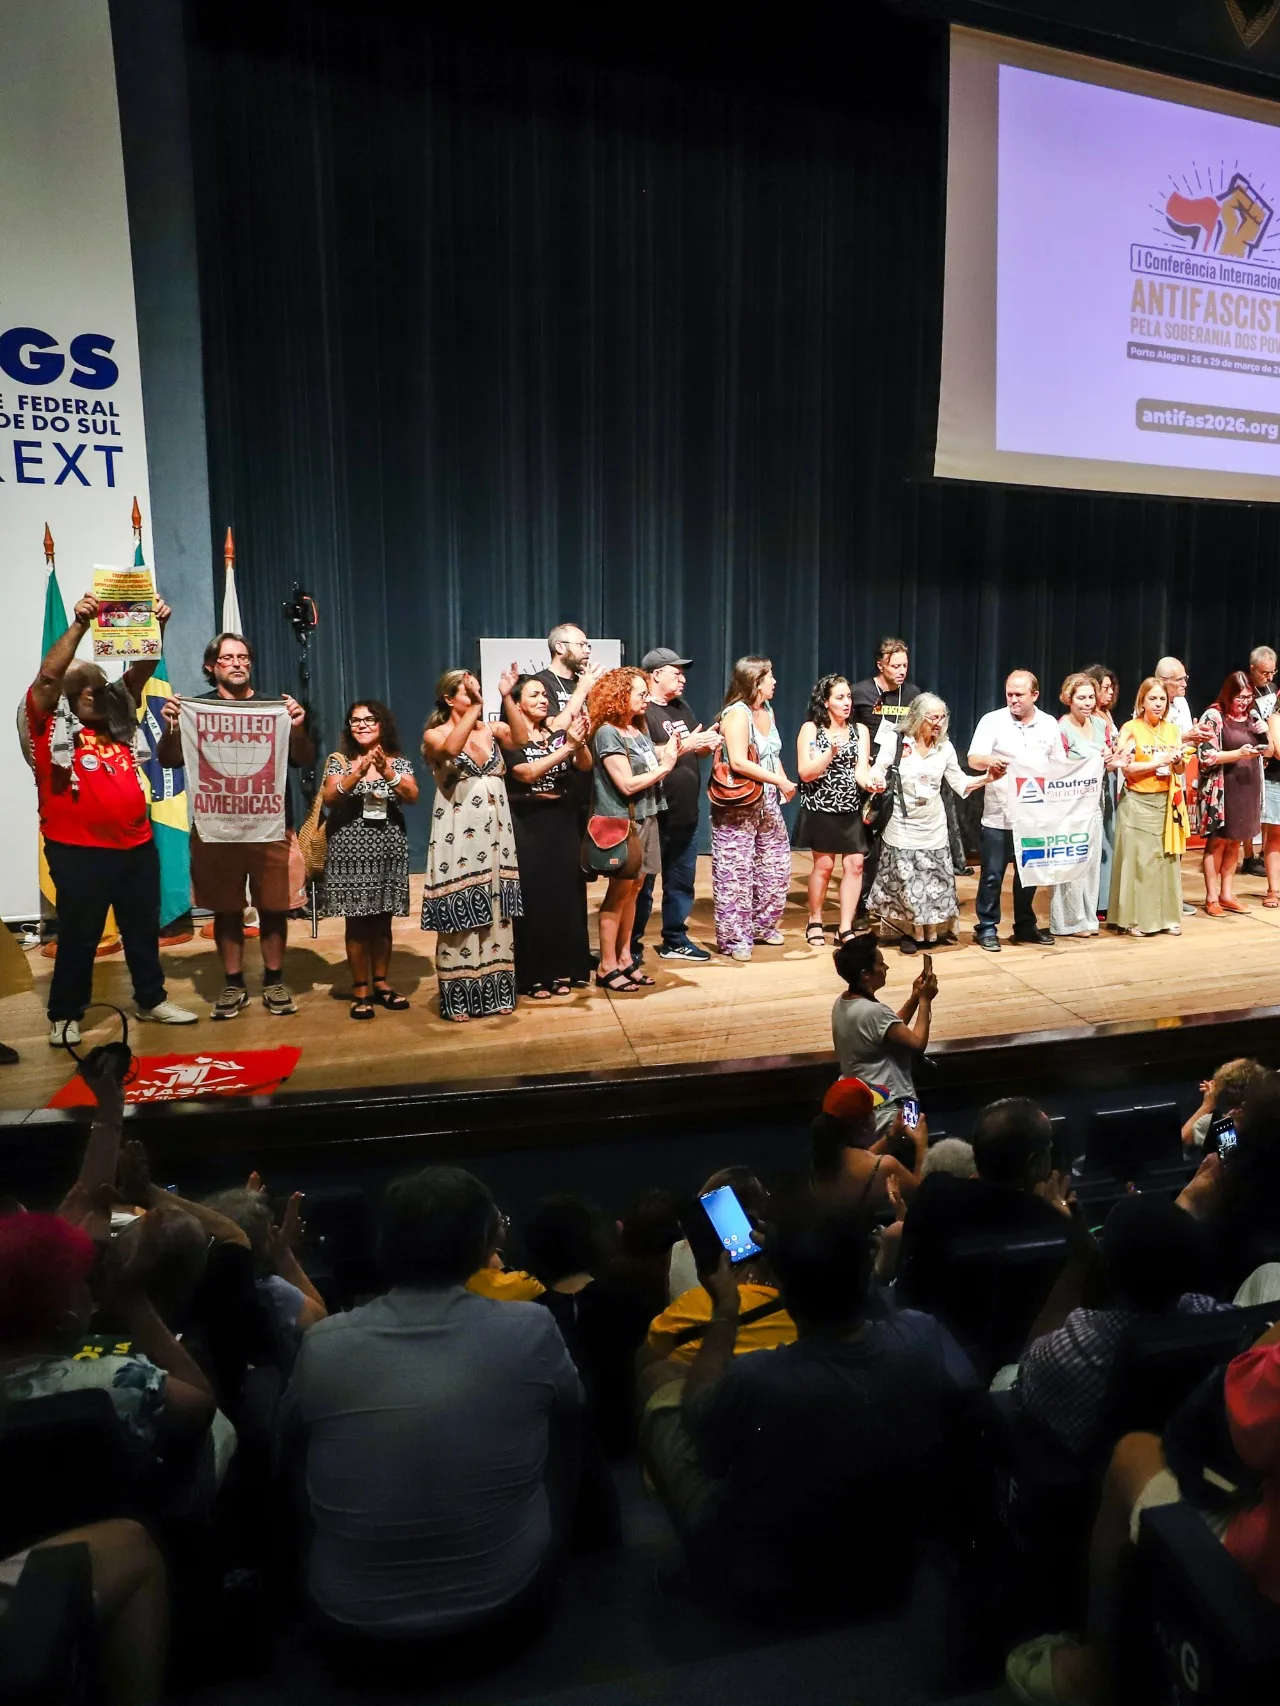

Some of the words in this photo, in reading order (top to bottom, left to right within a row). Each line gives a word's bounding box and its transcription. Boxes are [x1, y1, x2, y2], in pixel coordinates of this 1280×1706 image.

[1144, 251, 1216, 280] Conferência
[1130, 317, 1161, 339] PELA
[1165, 322, 1231, 348] SOBERANIA
[1235, 332, 1257, 351] DOS
[1130, 346, 1155, 358] Porto
[1156, 350, 1185, 363] Alegre
[1210, 358, 1220, 366] 29
[1222, 360, 1232, 368] de
[1234, 362, 1260, 373] março
[1261, 364, 1272, 373] de
[18, 394, 120, 418] FEDERAL
[32, 414, 70, 433] DO
[78, 418, 121, 435] SUL
[1142, 408, 1279, 440] antifas2026.org
[0, 439, 123, 488] EXT
[198, 714, 274, 734] JUBILEO
[199, 778, 275, 795] SUR
[1047, 777, 1098, 790] ADufrgs
[1047, 784, 1099, 799] sindical
[194, 793, 282, 815] AMERICAS
[1047, 832, 1089, 847] PRO
[1047, 844, 1089, 859] IFES
